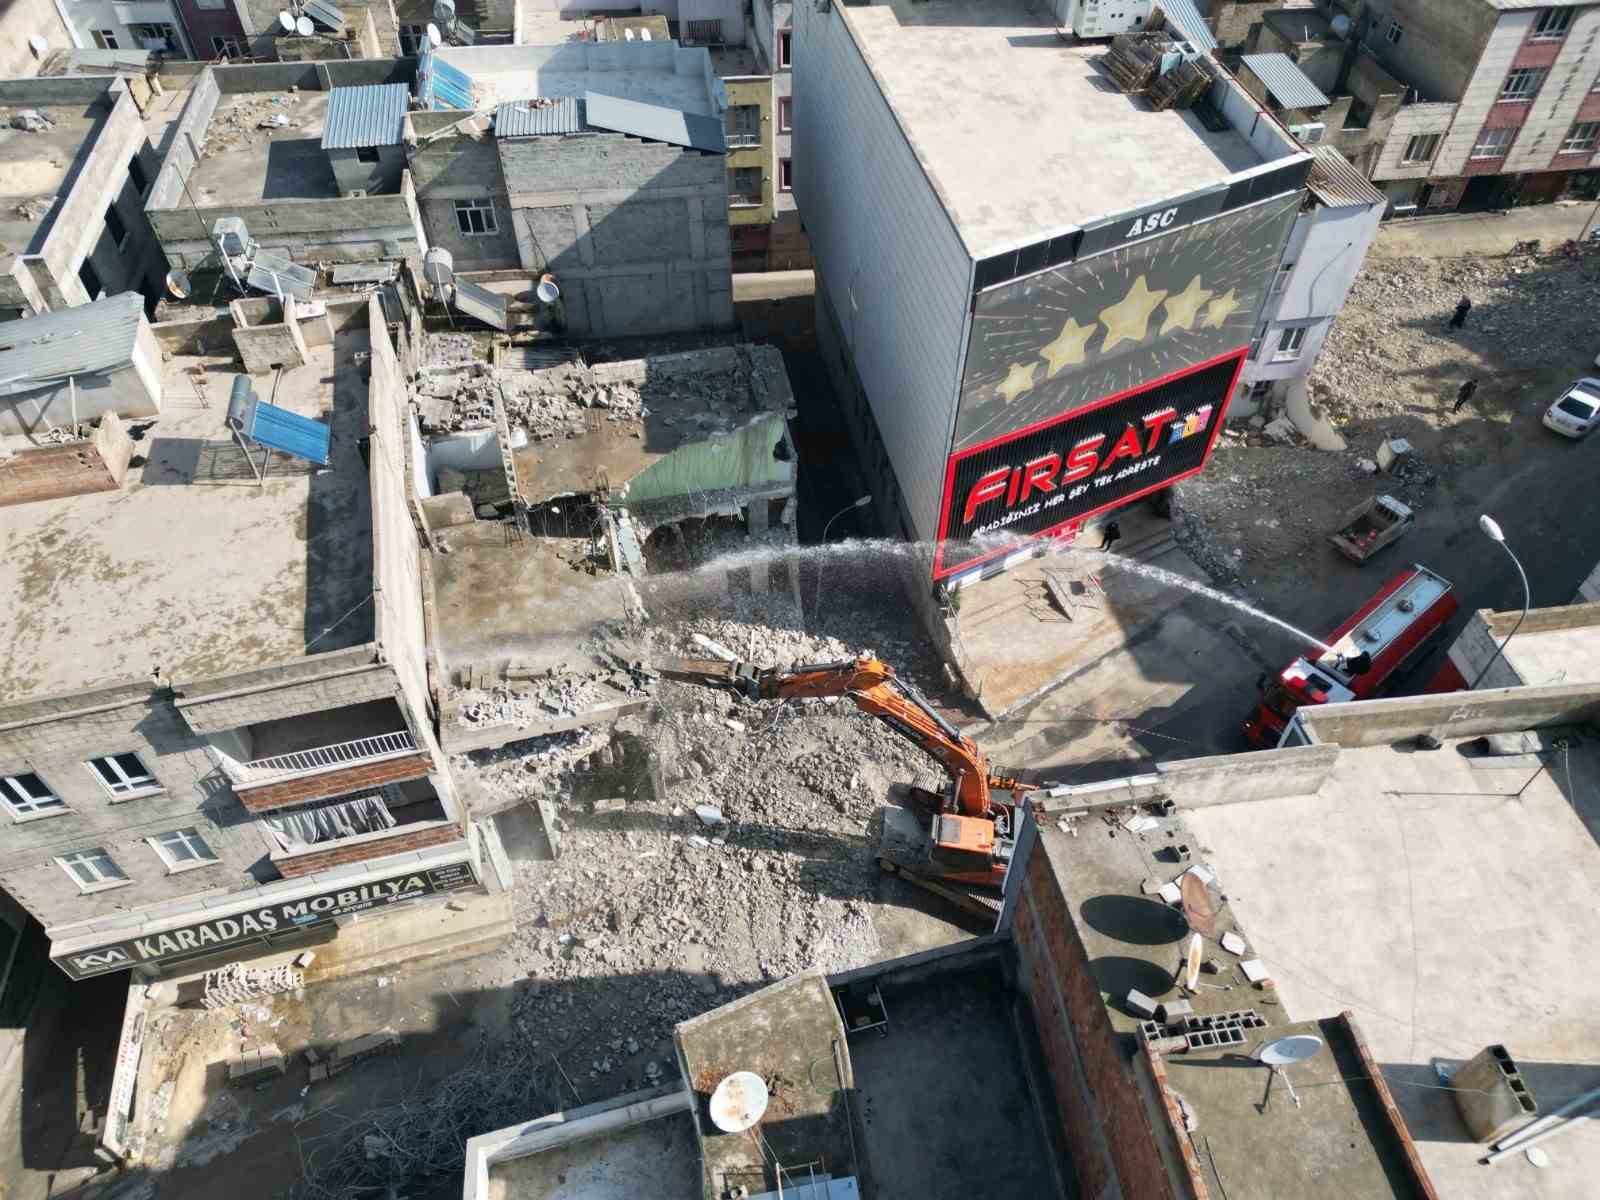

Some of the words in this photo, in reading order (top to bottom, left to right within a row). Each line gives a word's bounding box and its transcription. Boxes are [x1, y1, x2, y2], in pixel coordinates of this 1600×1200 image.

[1126, 208, 1178, 238] ASC
[963, 407, 1177, 524] FIRSAT
[1044, 494, 1066, 509] HER
[1094, 475, 1113, 489] TEK
[1114, 455, 1162, 481] ADRESTE
[134, 908, 278, 960] KARADAŞ
[282, 875, 426, 919] MOBİLYA
